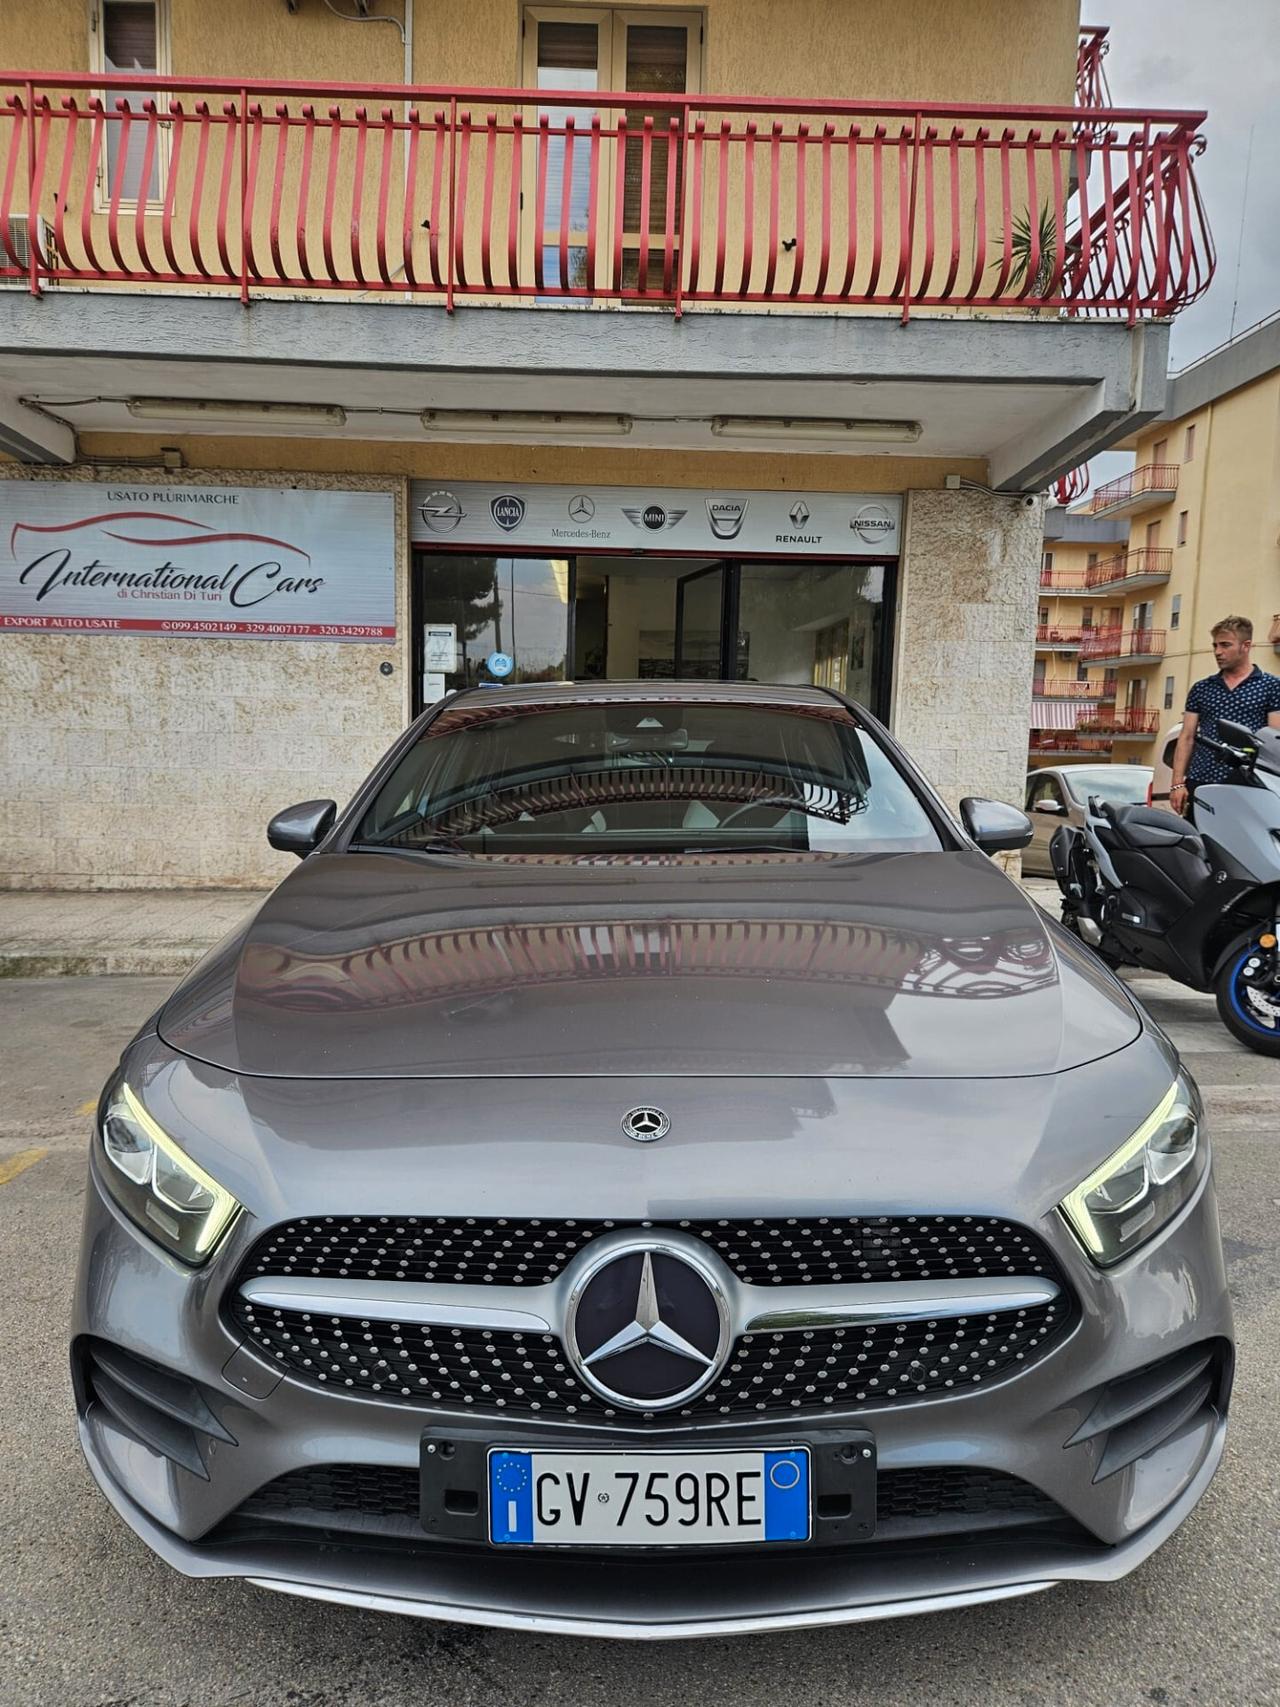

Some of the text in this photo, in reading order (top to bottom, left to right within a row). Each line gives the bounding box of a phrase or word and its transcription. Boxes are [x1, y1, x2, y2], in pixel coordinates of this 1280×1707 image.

[107, 491, 240, 505] USATO PLURIMARCHE
[496, 506, 520, 518] LANCIA
[712, 504, 741, 512] DACIA
[644, 513, 665, 523] MINI
[853, 519, 891, 528] NISSAN
[551, 528, 611, 539] Mercedes-Benz
[775, 535, 823, 544] RENAULT
[19, 548, 327, 608] International Cars
[117, 588, 222, 601] di Christian Di Turi
[4, 617, 48, 627] EXPORT
[51, 618, 83, 628] AUTO
[85, 619, 121, 629] USATE
[171, 622, 237, 633] 099.4502149
[246, 624, 310, 635] 329.4007177
[319, 625, 384, 637] 320.3429788
[536, 1470, 762, 1527] GV 759RE
